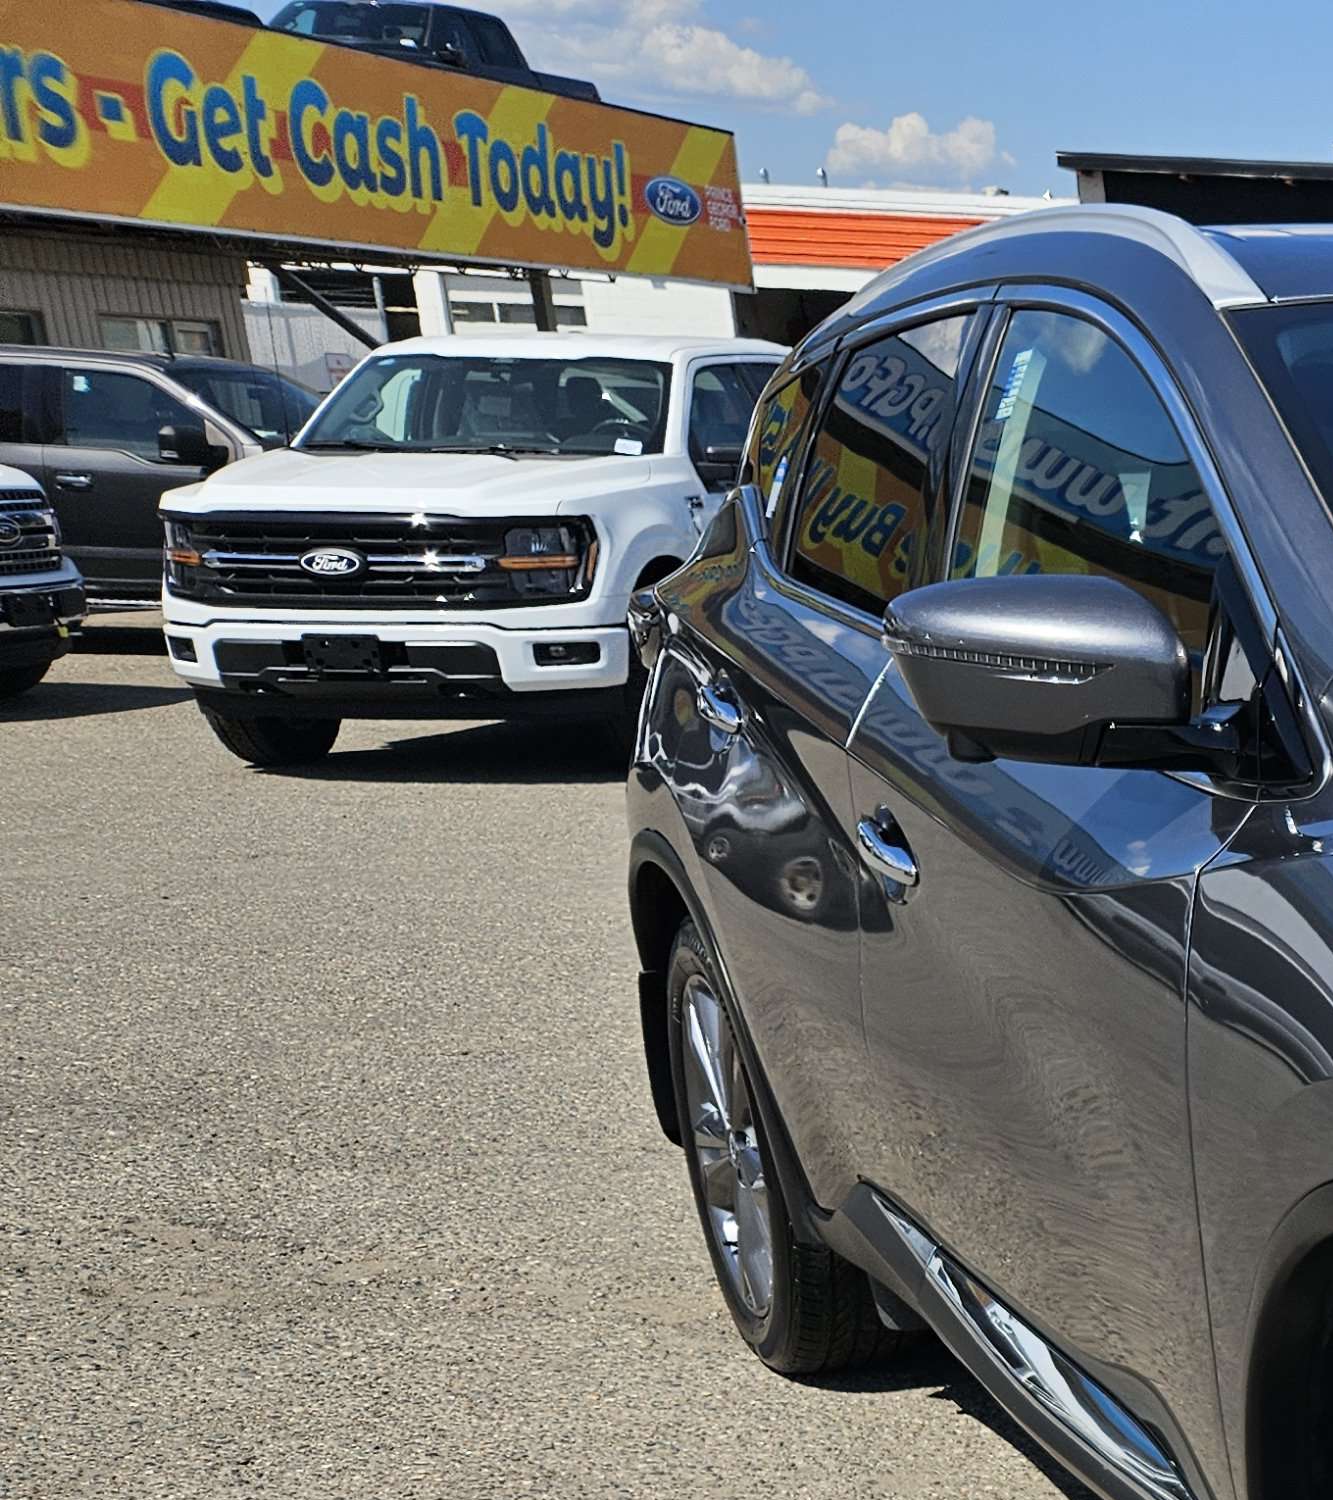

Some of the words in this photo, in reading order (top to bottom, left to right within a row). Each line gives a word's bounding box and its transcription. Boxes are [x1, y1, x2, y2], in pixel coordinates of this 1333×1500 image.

[147, 50, 274, 178] Get
[289, 79, 443, 201] Cash
[455, 112, 629, 248] Today!
[655, 181, 693, 218] Ford
[311, 554, 348, 571] Ford
